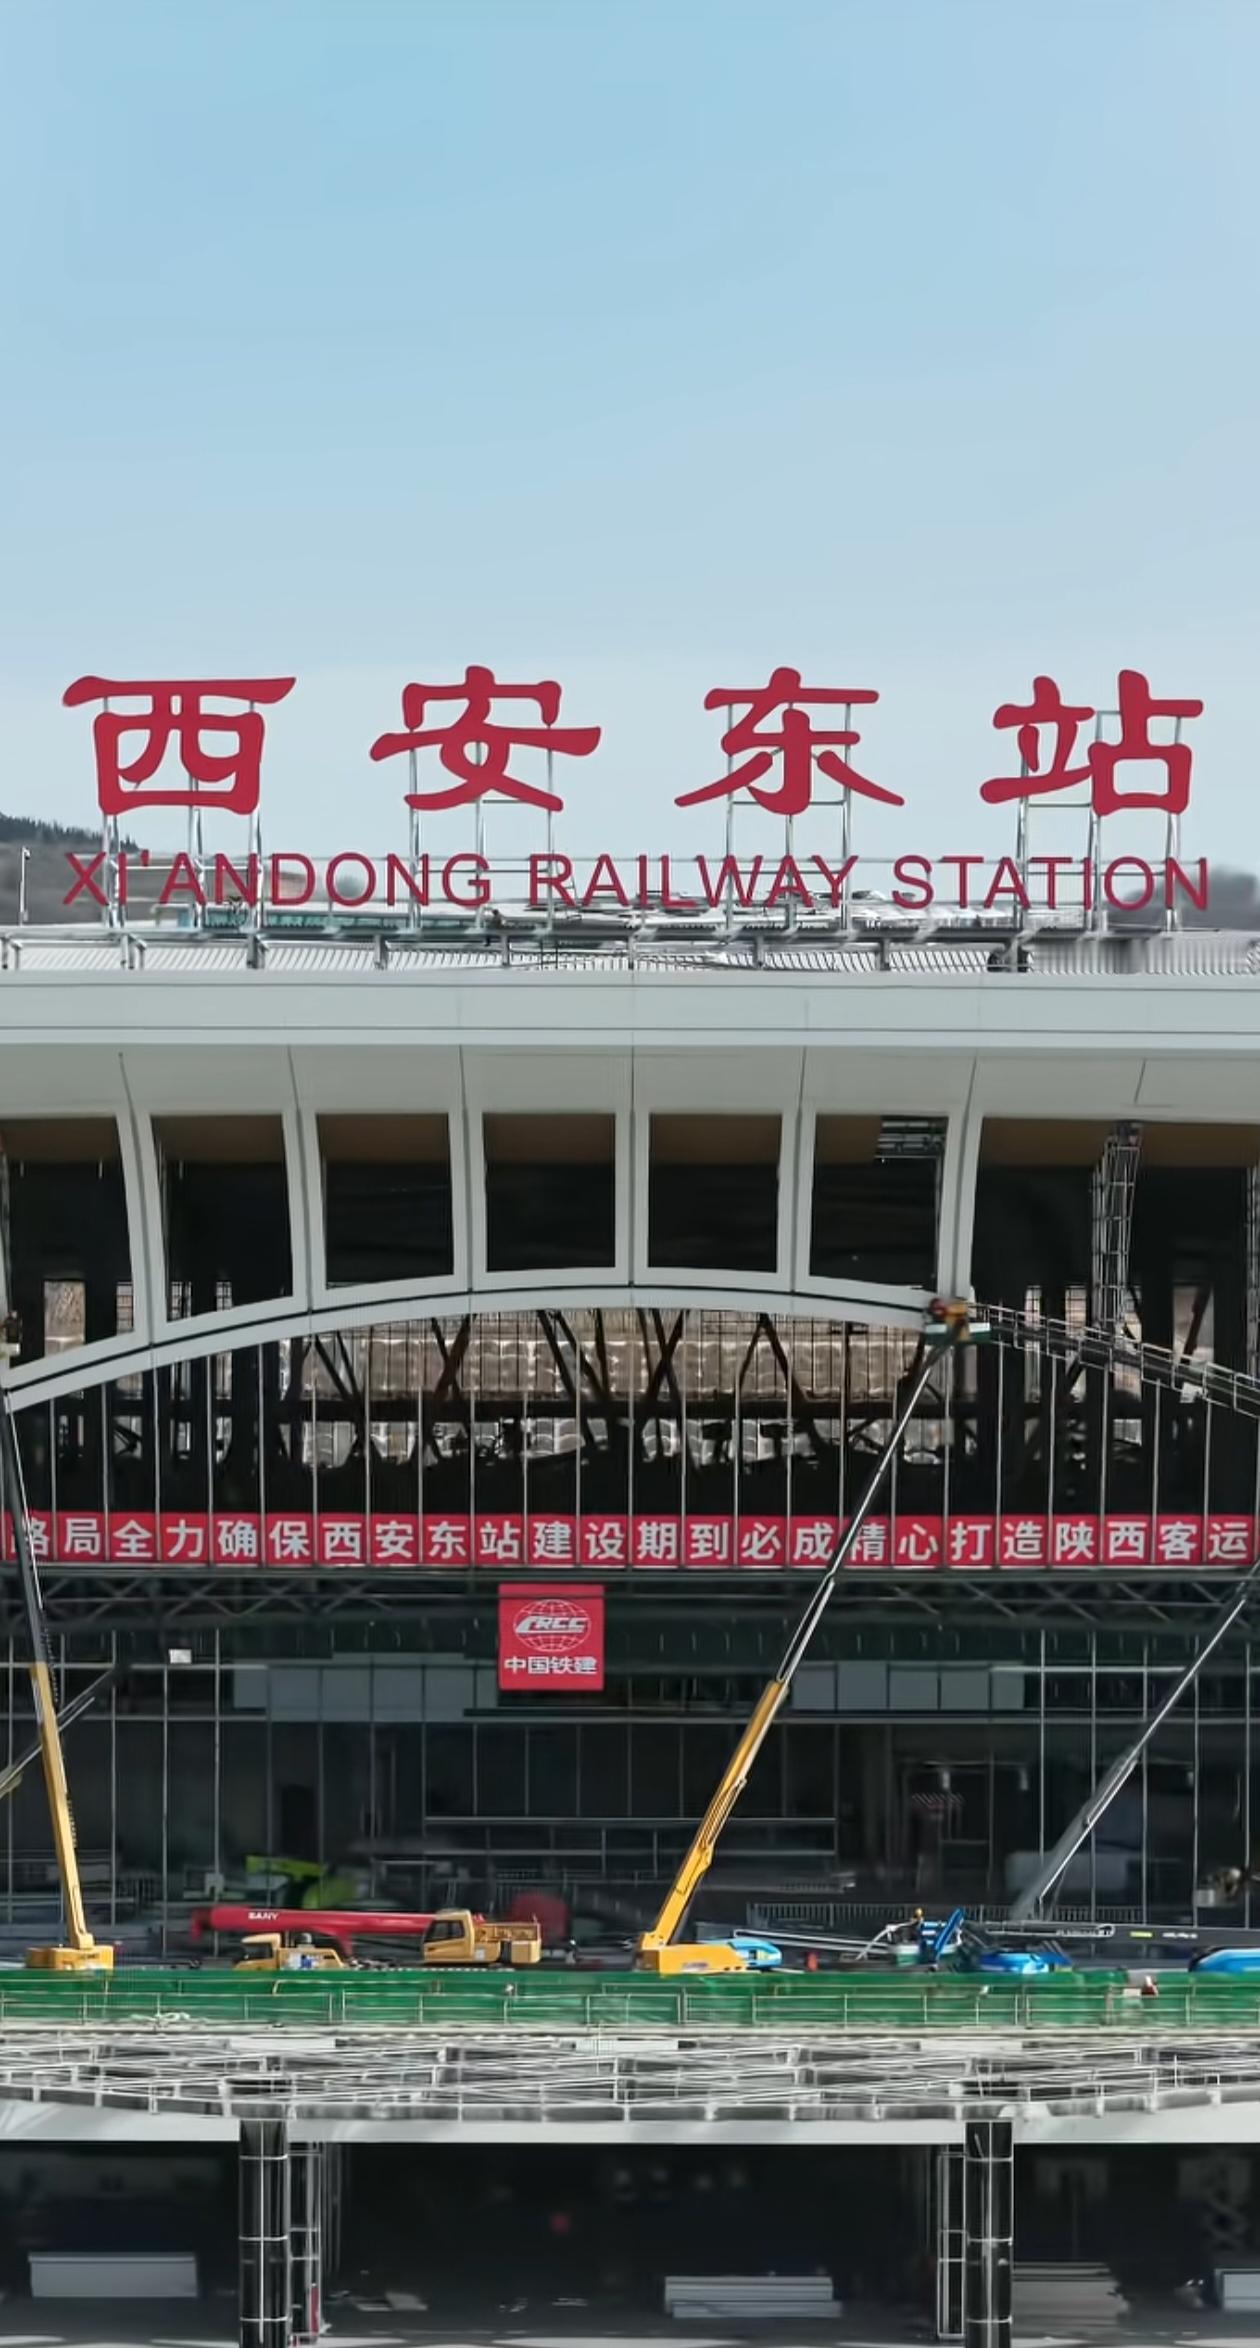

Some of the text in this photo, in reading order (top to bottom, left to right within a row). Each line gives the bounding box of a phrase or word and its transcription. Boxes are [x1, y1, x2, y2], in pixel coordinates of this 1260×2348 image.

[63, 667, 1203, 816] 西安东站
[63, 850, 1208, 910] XI'ANDONG RAILWAY STATION
[504, 1656, 597, 1675] 中国铁建
[248, 1911, 279, 1920] SANY
